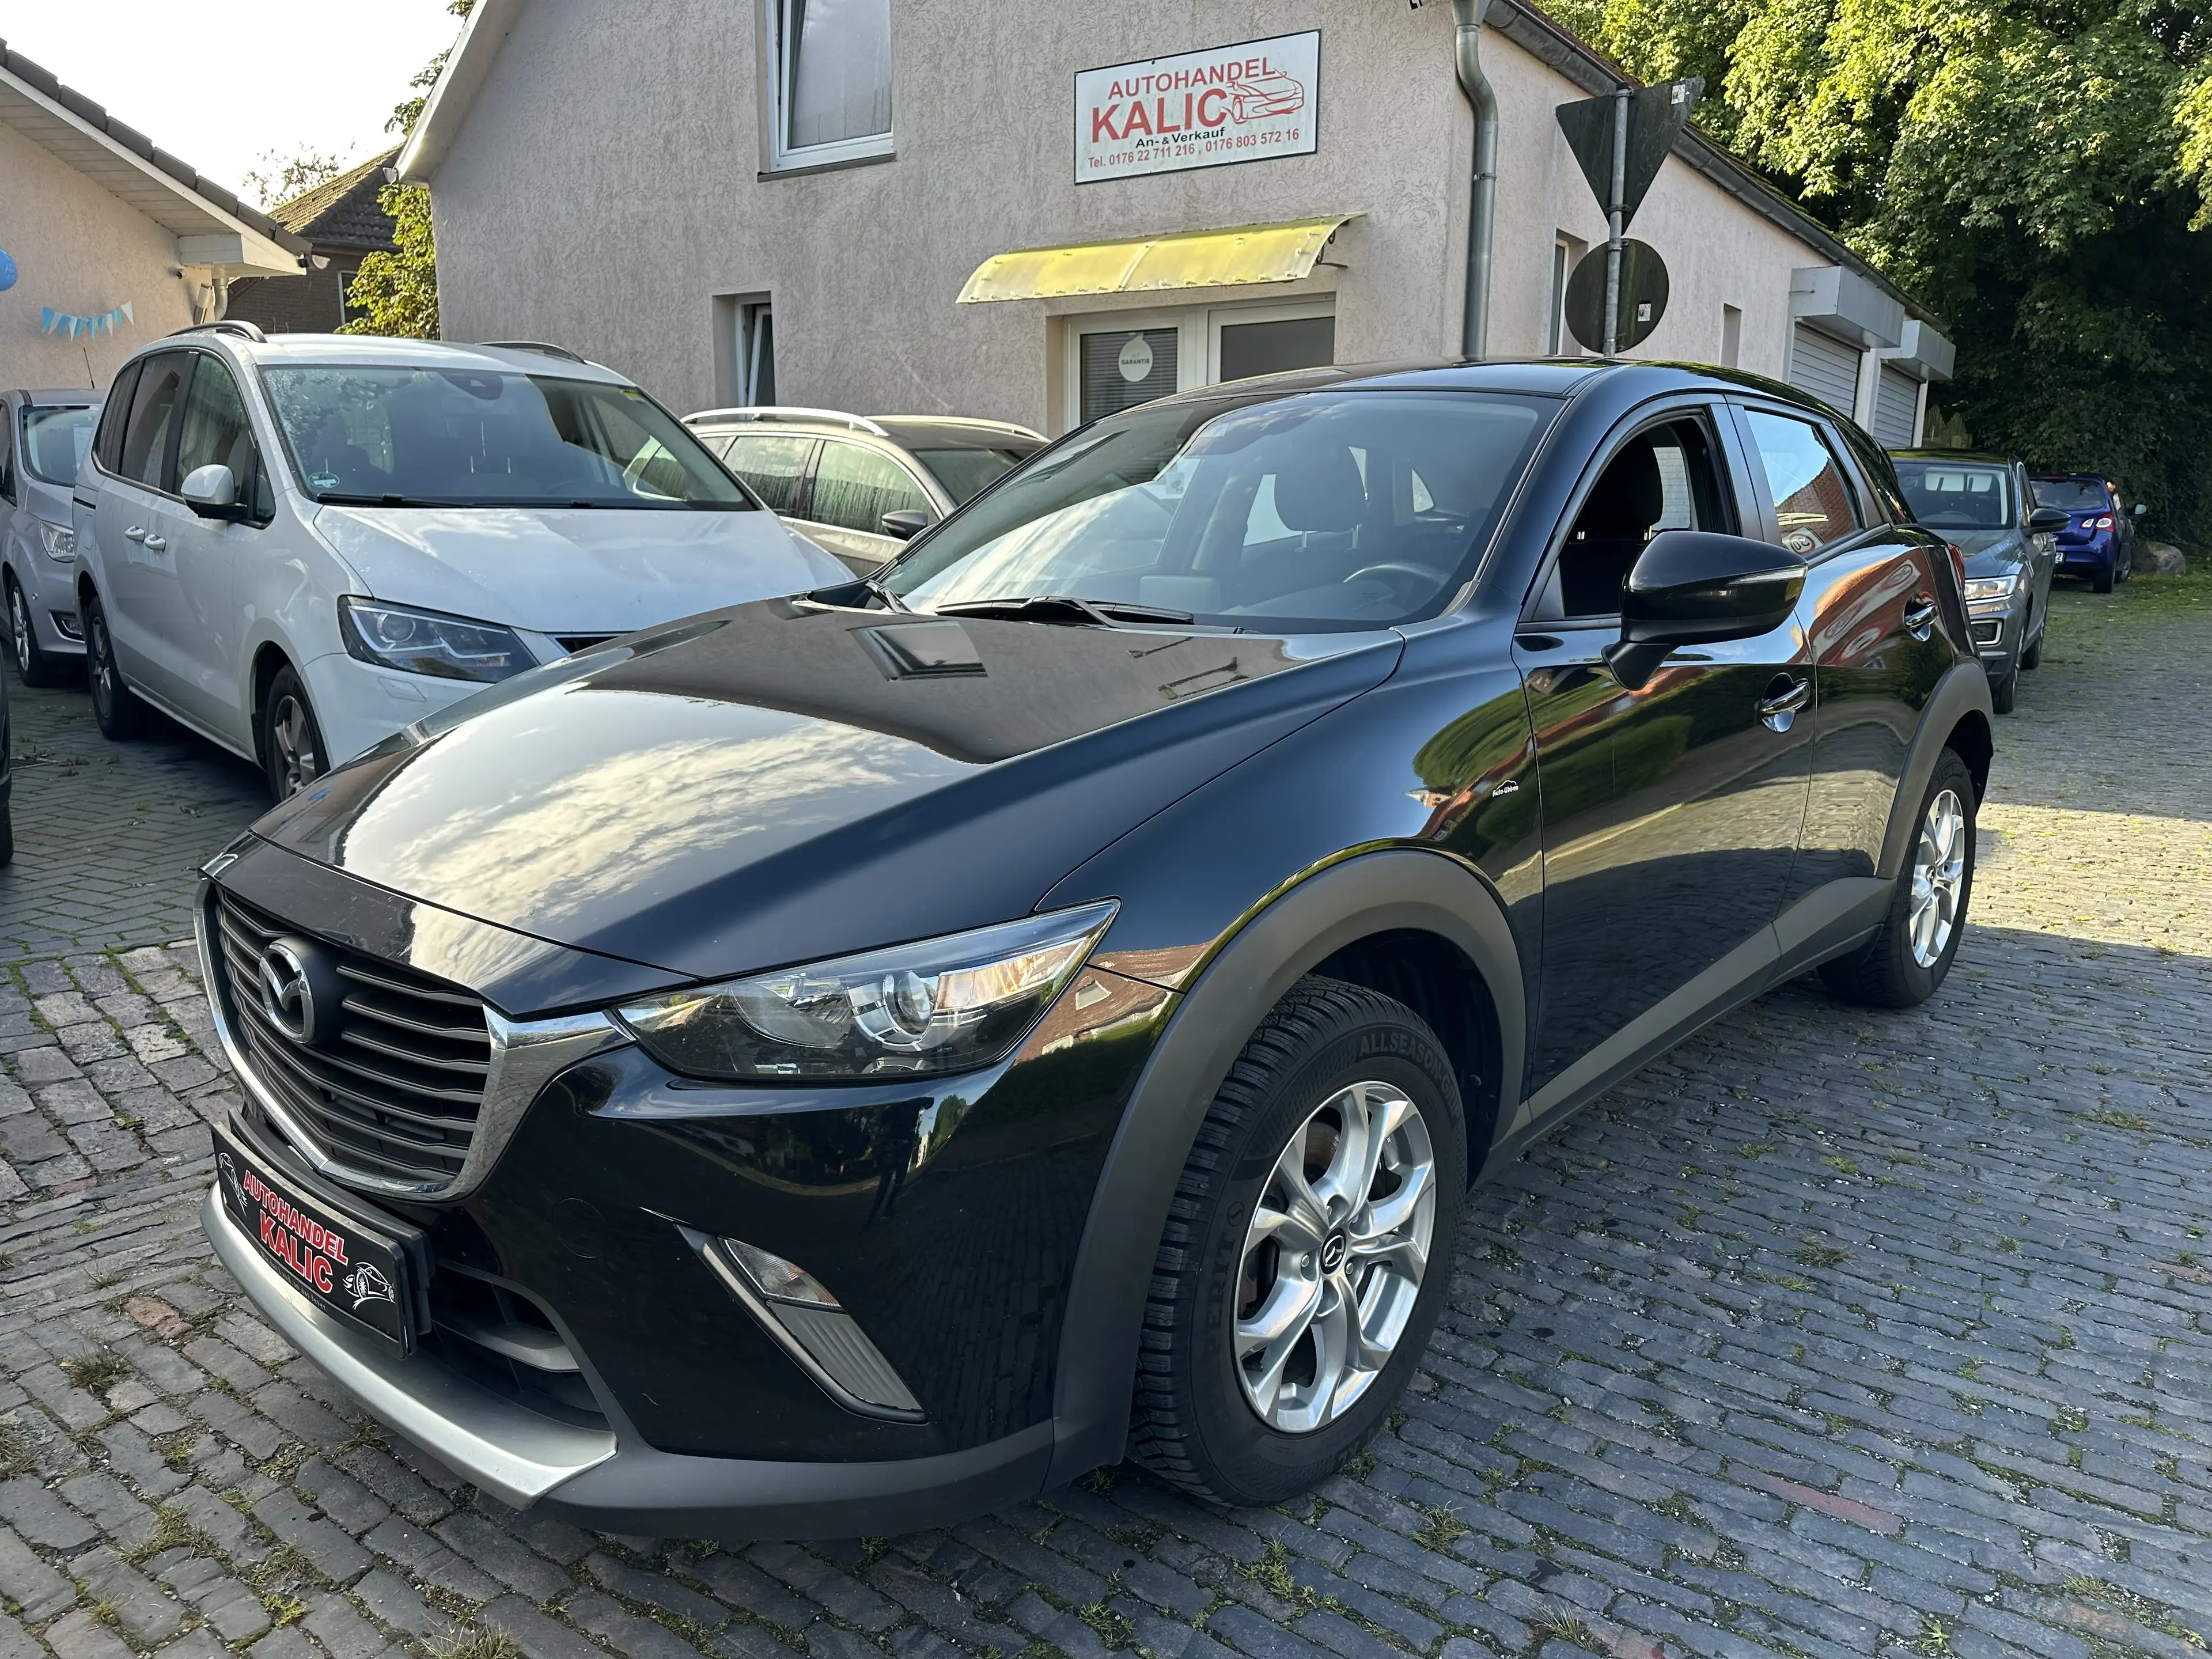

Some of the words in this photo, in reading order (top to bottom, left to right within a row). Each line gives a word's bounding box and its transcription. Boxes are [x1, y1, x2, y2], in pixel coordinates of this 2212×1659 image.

[1108, 57, 1275, 100] AUTOHANDEL
[1092, 88, 1228, 143] KALIC
[1135, 138, 1160, 149] An-
[1162, 137, 1169, 145] &
[1172, 127, 1225, 143] Verkauf
[1088, 156, 1106, 168] Tel.
[1109, 151, 1134, 165] 0176
[1137, 149, 1150, 162] 22
[1154, 146, 1171, 159] 711
[1175, 144, 1195, 157] 216
[1206, 138, 1232, 151] 0176
[1236, 134, 1256, 148] 803
[1260, 131, 1281, 145] 572
[1286, 128, 1299, 141] 16
[243, 1169, 349, 1266] AUTOHANDEL
[260, 1209, 333, 1294] KALIC
